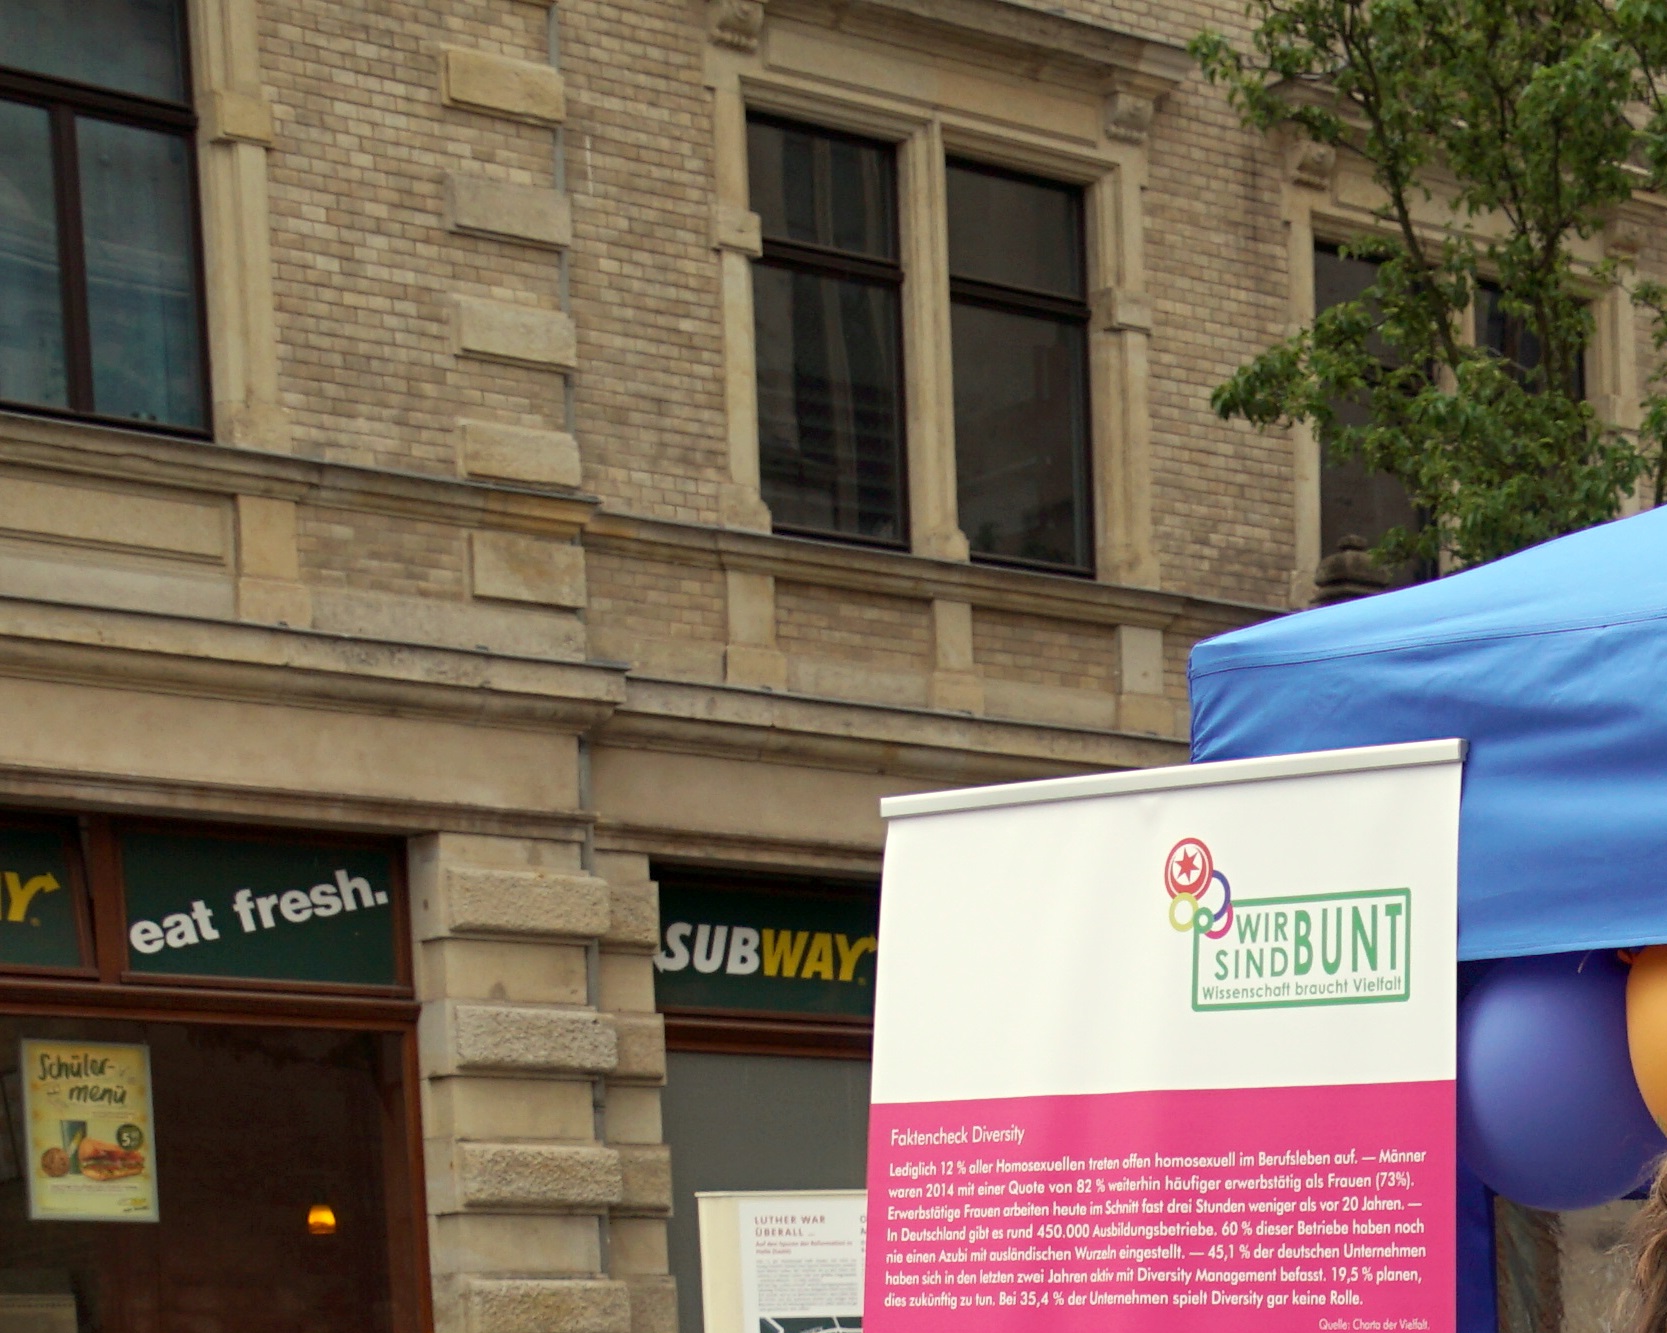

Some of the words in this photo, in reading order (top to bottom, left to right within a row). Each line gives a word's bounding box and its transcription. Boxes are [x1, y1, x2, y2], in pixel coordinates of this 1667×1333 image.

[0, 871, 60, 922] Y
[129, 900, 220, 953] eat
[233, 869, 388, 933] fresh.
[1236, 911, 1288, 944] WIR
[1294, 903, 1402, 976] BUNT
[653, 921, 876, 983] SUBWAY
[1214, 947, 1288, 980] SIND
[1202, 982, 1290, 1000] Wissenschaft
[1295, 978, 1348, 996] braucht
[1353, 976, 1402, 993] Vielfalt
[69, 1084, 127, 1104] menü
[891, 1126, 968, 1146] Faktencheck
[972, 1124, 1024, 1145] Diversity
[890, 1162, 936, 1178] Lediglich
[941, 1161, 953, 1175] 12
[969, 1159, 993, 1174] aller
[996, 1156, 1085, 1172] Homosexuellen
[1089, 1157, 1119, 1170] treten
[1122, 1153, 1150, 1168] offen
[1155, 1152, 1235, 1167] homosexuell
[1240, 1152, 1254, 1166] im
[1259, 1150, 1330, 1166] Berufsleben
[1334, 1149, 1357, 1164] auf.
[1379, 1149, 1426, 1163] Männer
[754, 1216, 797, 1225] LUTHER
[801, 1216, 826, 1224] WAR
[755, 1228, 803, 1237] ÜBERALL
